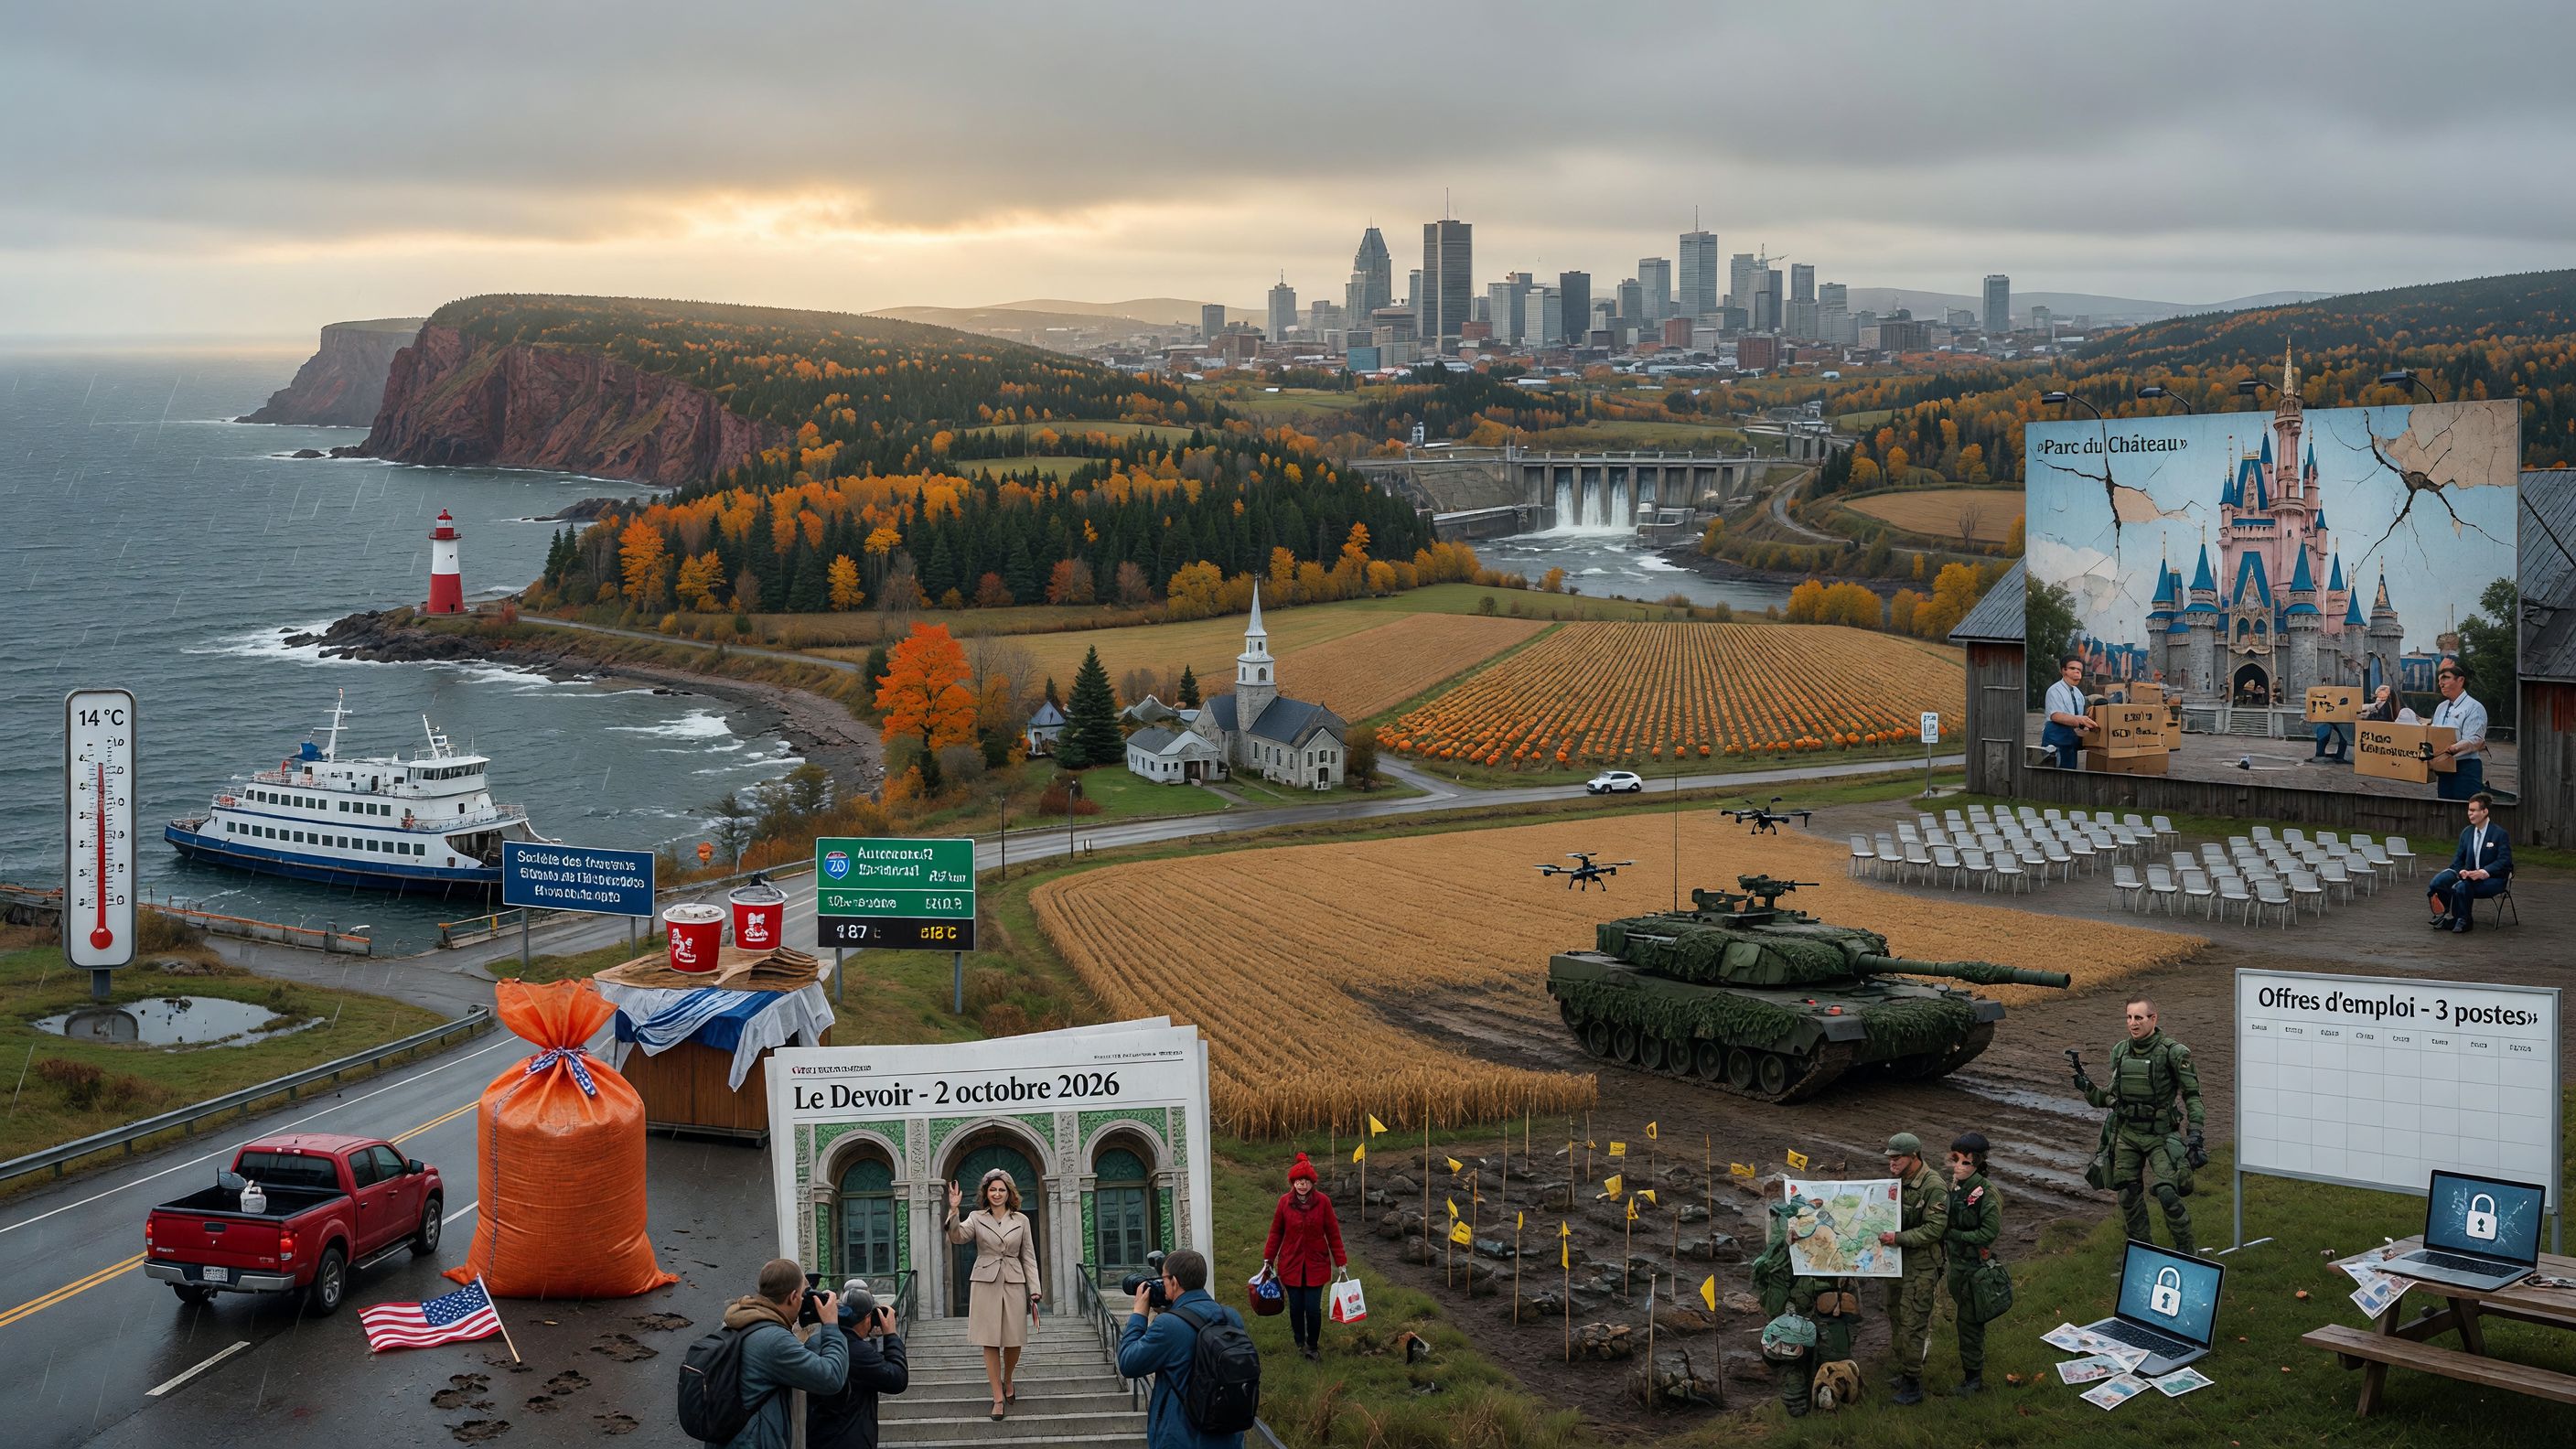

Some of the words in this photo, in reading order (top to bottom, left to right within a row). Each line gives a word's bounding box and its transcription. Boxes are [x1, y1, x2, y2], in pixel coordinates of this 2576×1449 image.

[2084, 437, 2102, 454] du
[2108, 434, 2188, 453] Château»
[79, 709, 100, 726] 14
[103, 709, 124, 726] °C
[2259, 986, 2320, 1011] Offres
[2325, 991, 2416, 1022] d'emploi
[2435, 999, 2449, 1021] 3
[2454, 1004, 2538, 1027] postes»
[794, 1086, 824, 1111] Le
[830, 1082, 914, 1109] Devoir
[934, 1080, 950, 1105] 2
[955, 1075, 1051, 1104] octobre
[1057, 1071, 1121, 1099] 2026
